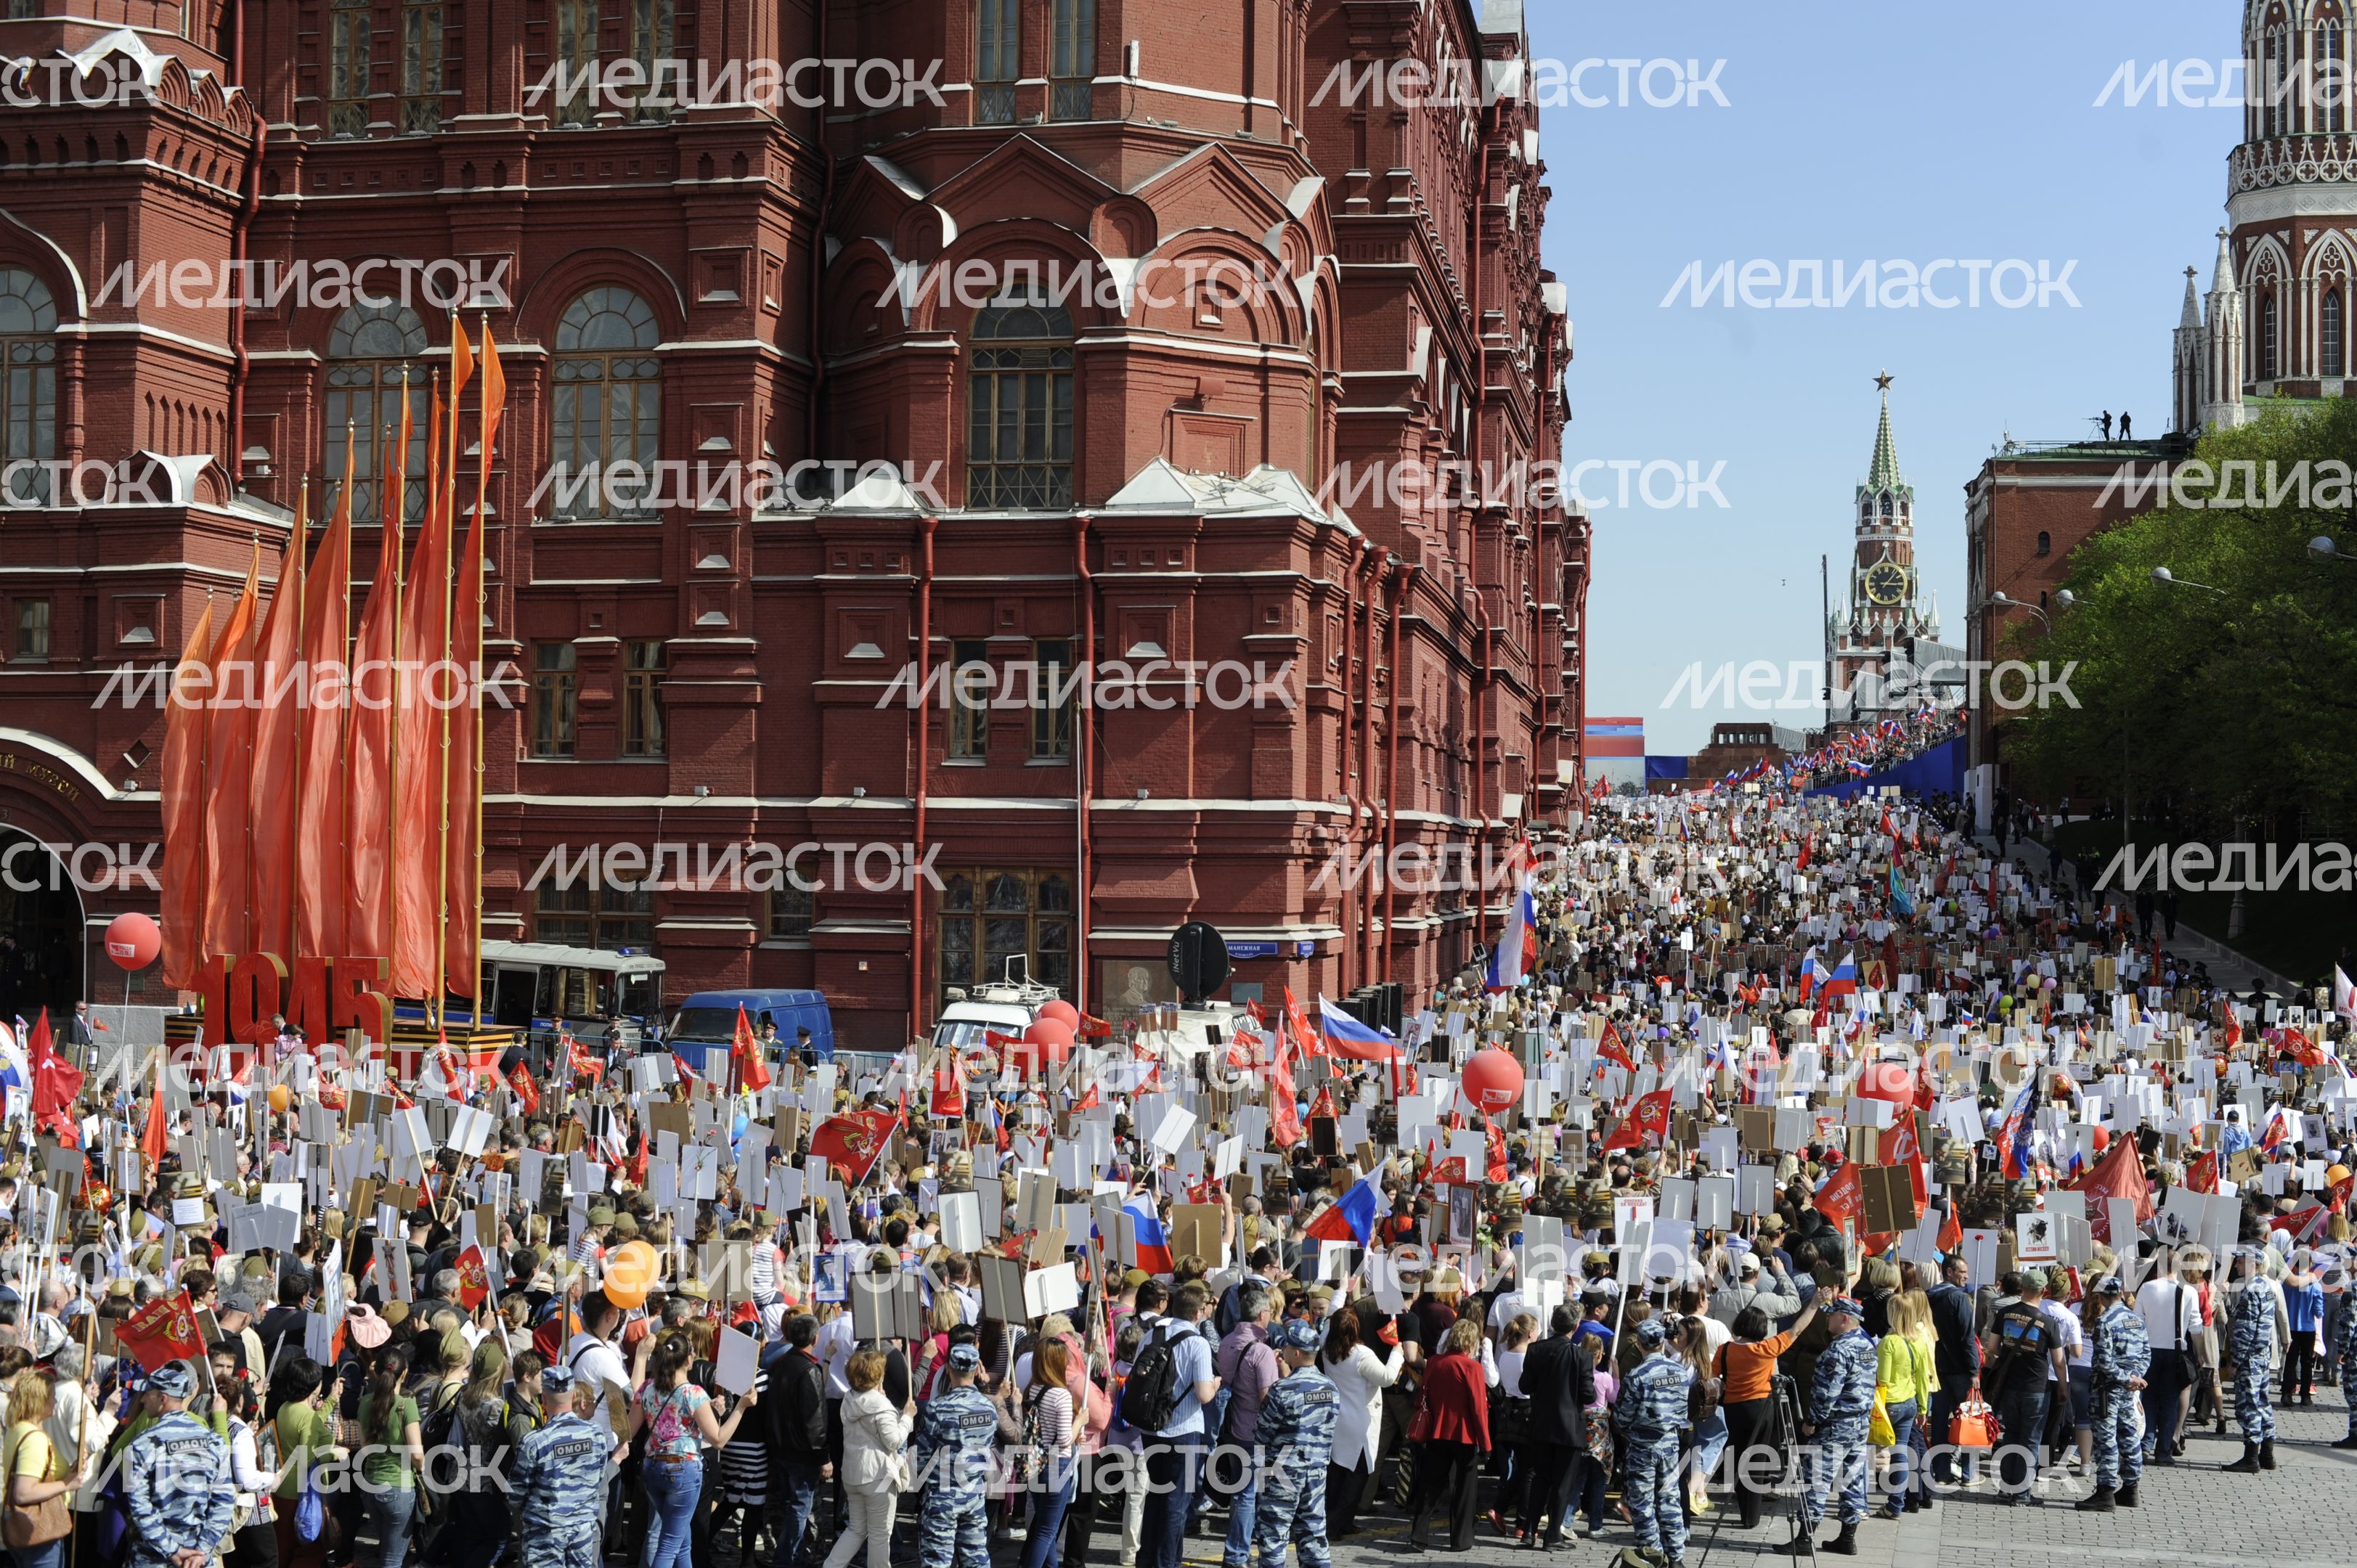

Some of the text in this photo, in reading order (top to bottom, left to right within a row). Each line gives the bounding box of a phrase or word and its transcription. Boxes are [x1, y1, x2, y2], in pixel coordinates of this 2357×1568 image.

[25, 764, 80, 802] МУЗЕЙ
[191, 952, 394, 1056] 1945
[1314, 1040, 1323, 1053] 79
[1654, 1375, 1681, 1388] ОМОН
[1306, 1392, 1332, 1402] ОМОН
[961, 1414, 991, 1427] ОМОН
[170, 1439, 208, 1450] ОМОН
[556, 1440, 591, 1456] ОМОН
